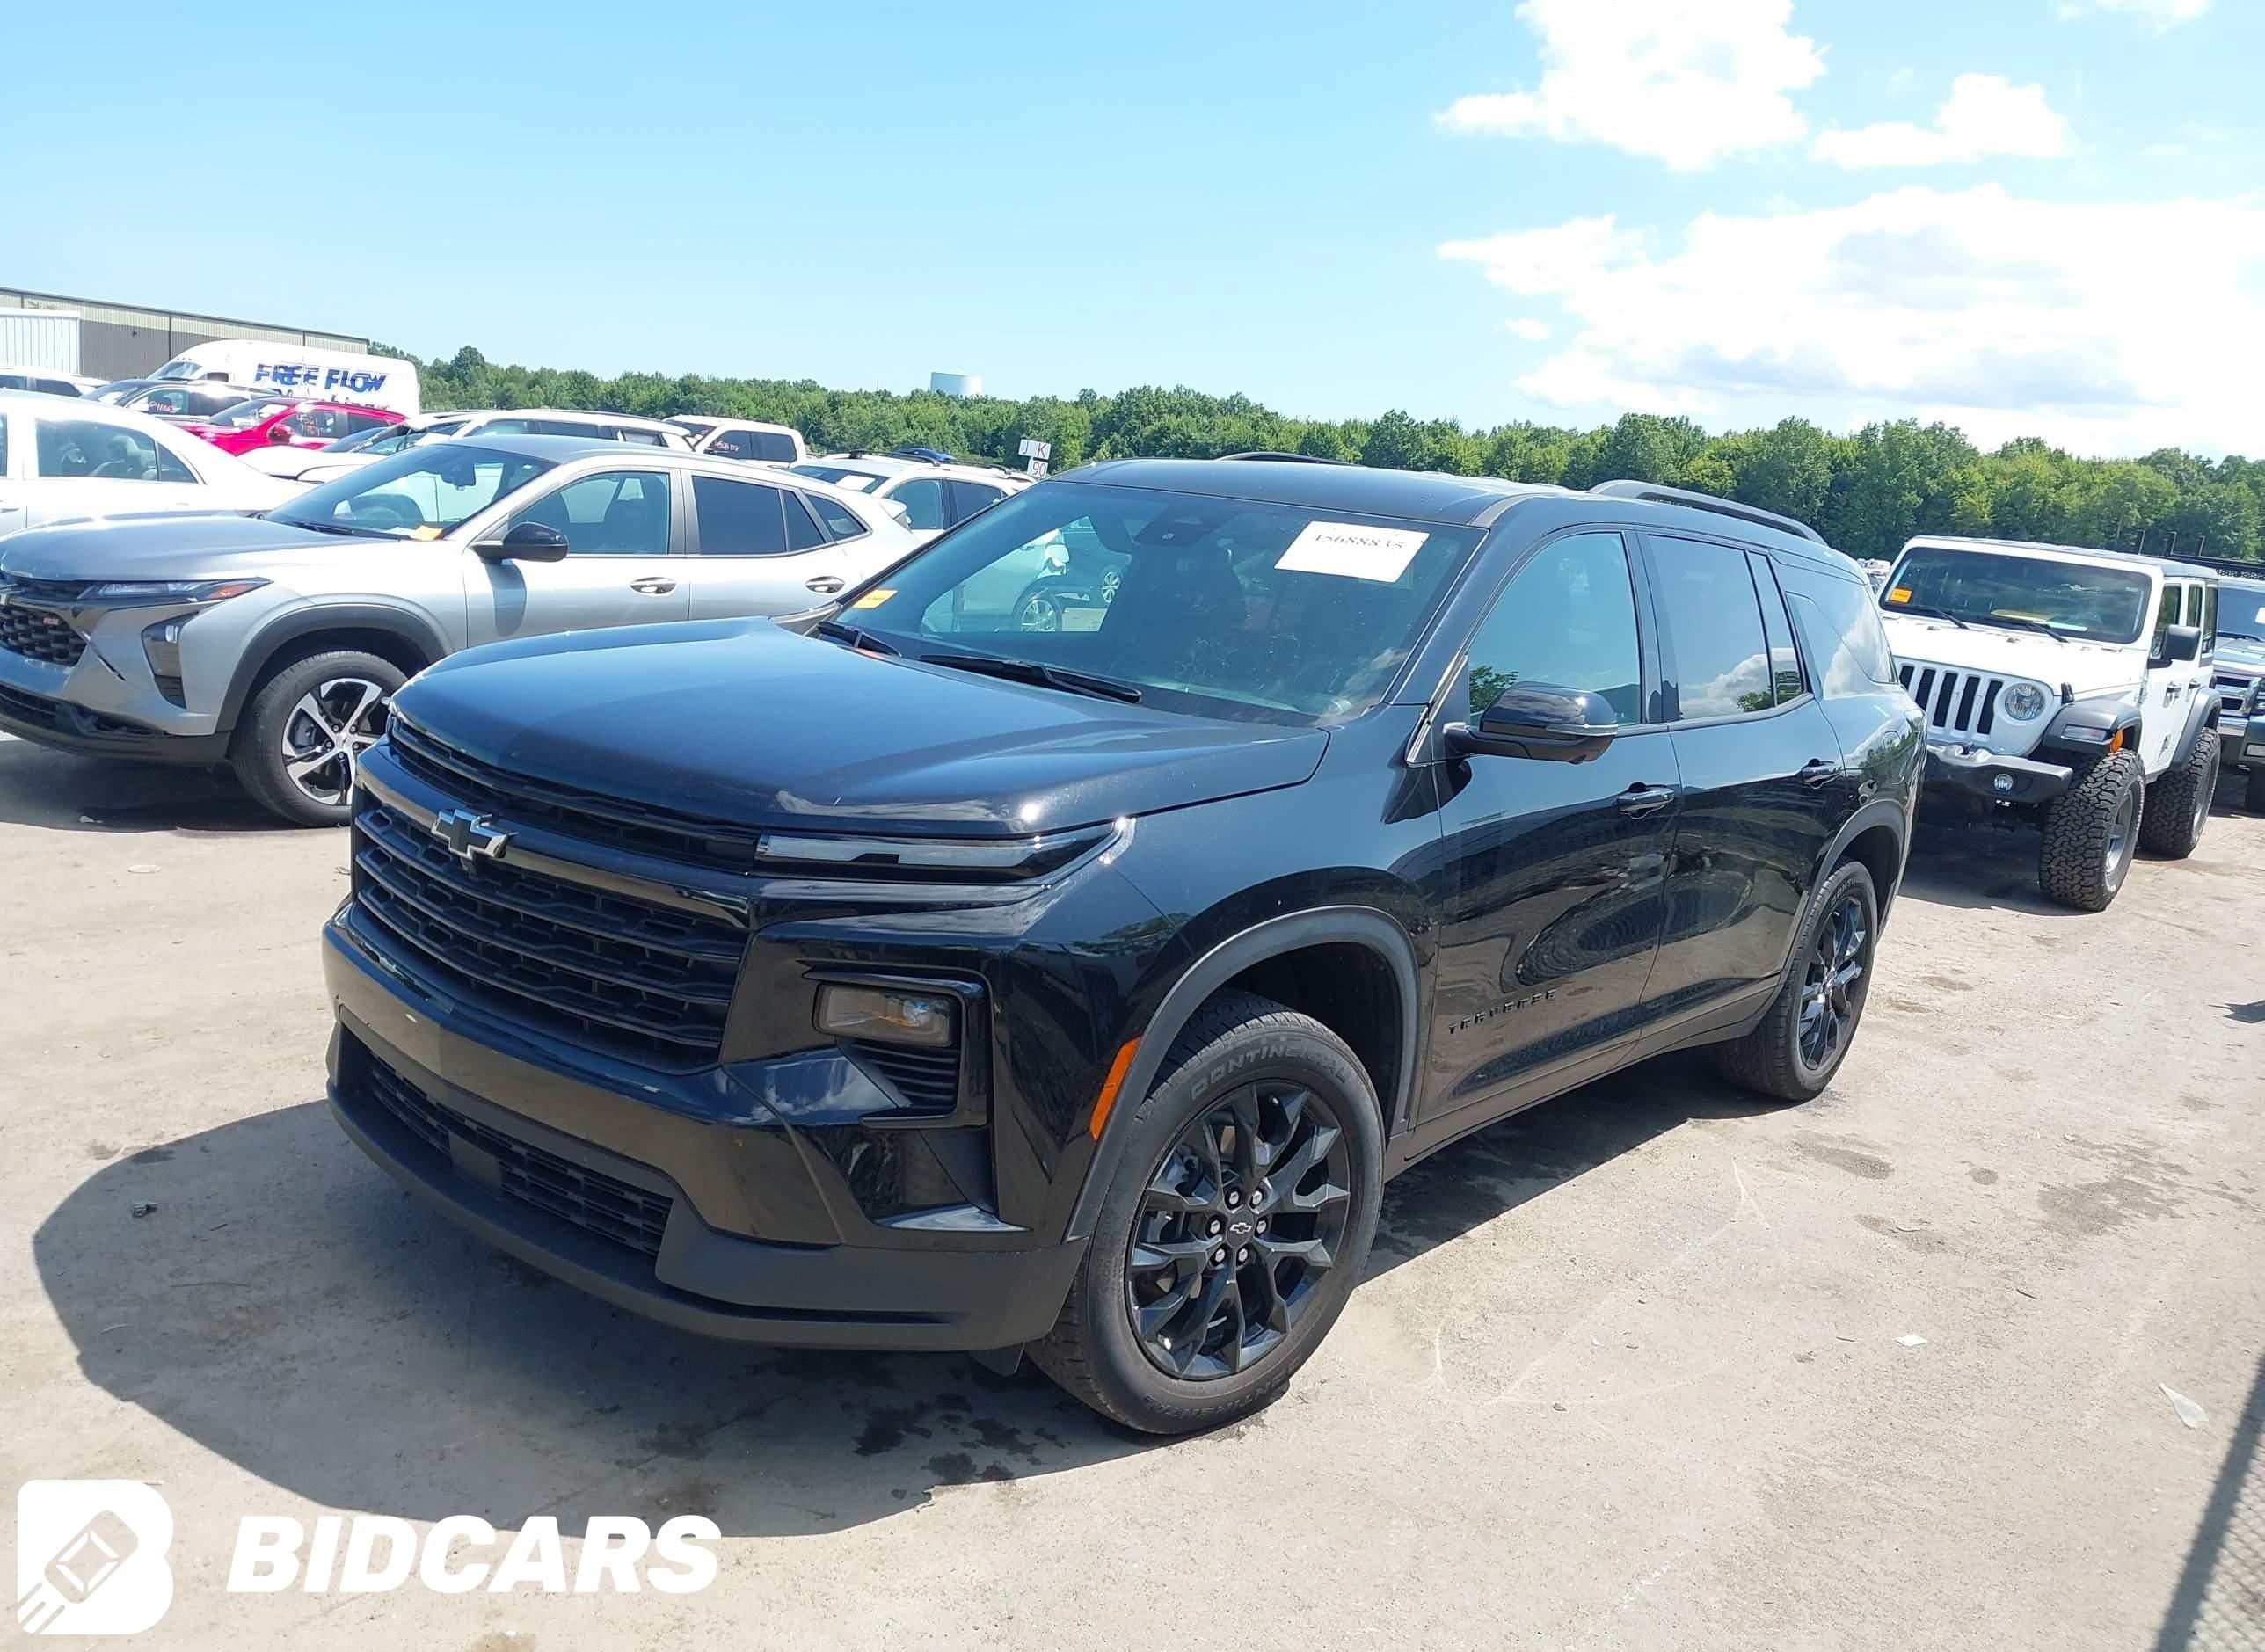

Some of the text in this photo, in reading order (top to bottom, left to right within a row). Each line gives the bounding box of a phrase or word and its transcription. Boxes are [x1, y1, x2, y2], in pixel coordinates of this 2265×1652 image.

[255, 363, 387, 392] FREE FLOW
[1023, 441, 1046, 457] J K
[1032, 462, 1046, 477] 90
[1191, 1043, 1347, 1099] CONTINENTAL
